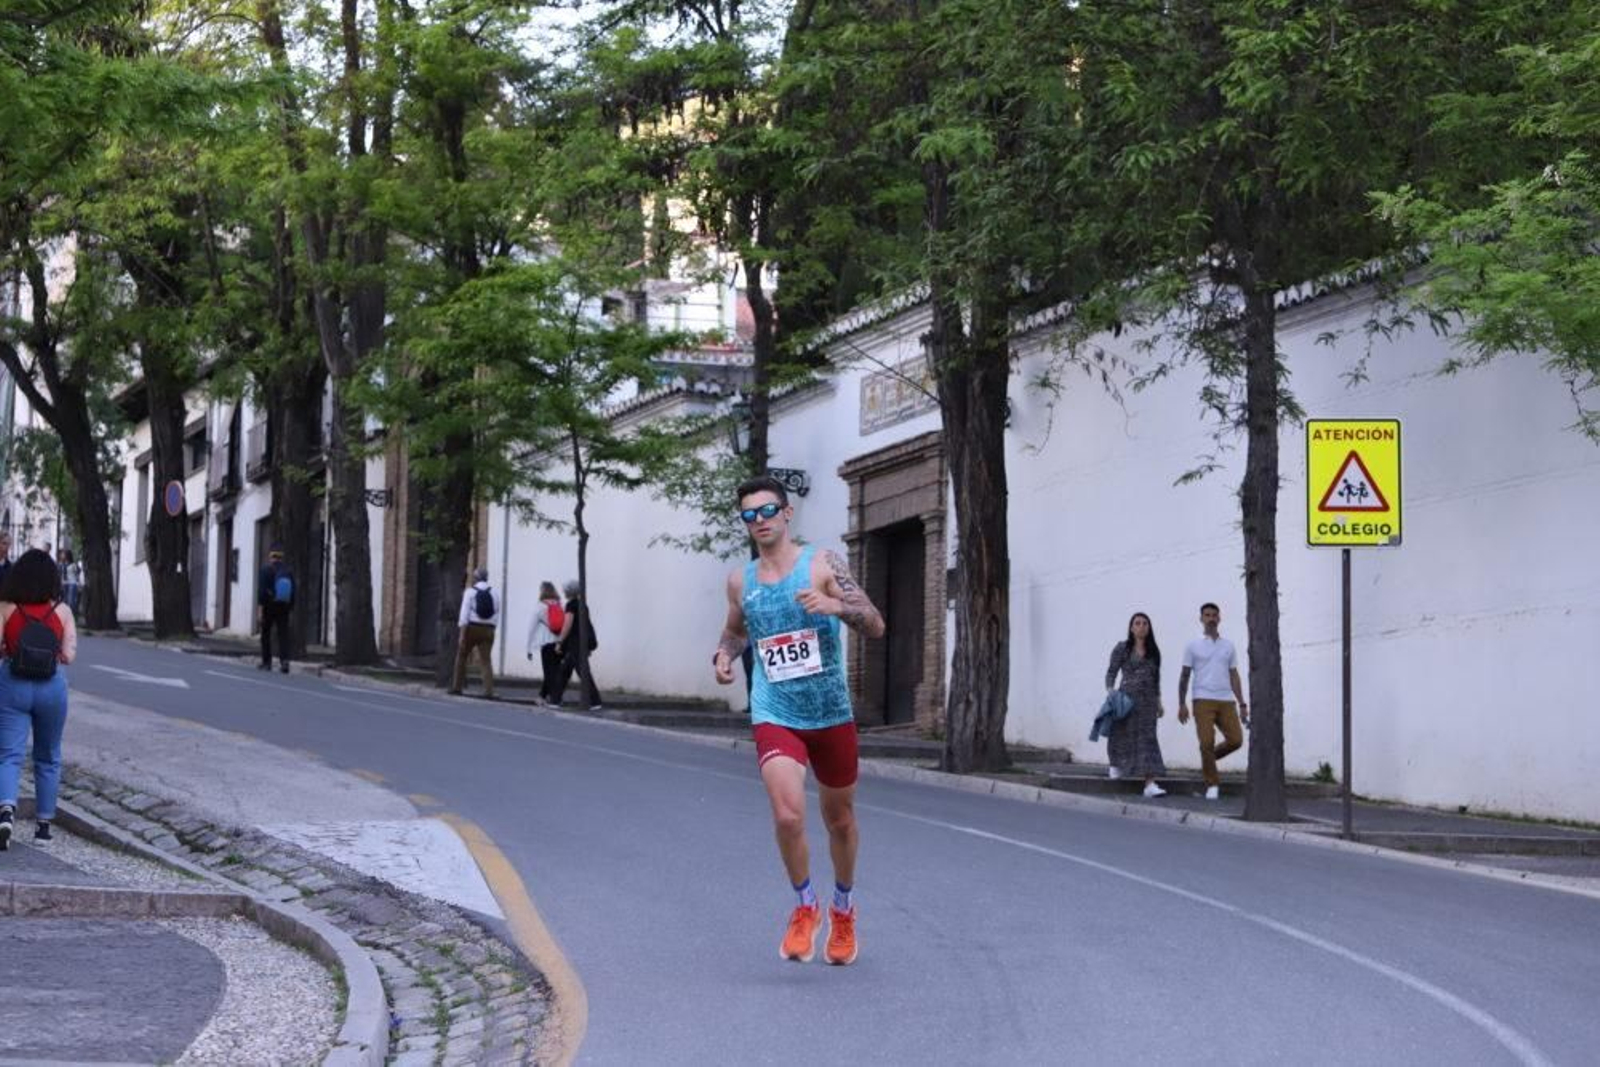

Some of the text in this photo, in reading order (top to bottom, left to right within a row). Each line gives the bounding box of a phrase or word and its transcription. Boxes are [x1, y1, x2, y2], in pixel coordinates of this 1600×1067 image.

[1312, 427, 1394, 441] ATENCIÓN
[1317, 523, 1392, 536] COLEGIO
[765, 640, 810, 667] 2158
